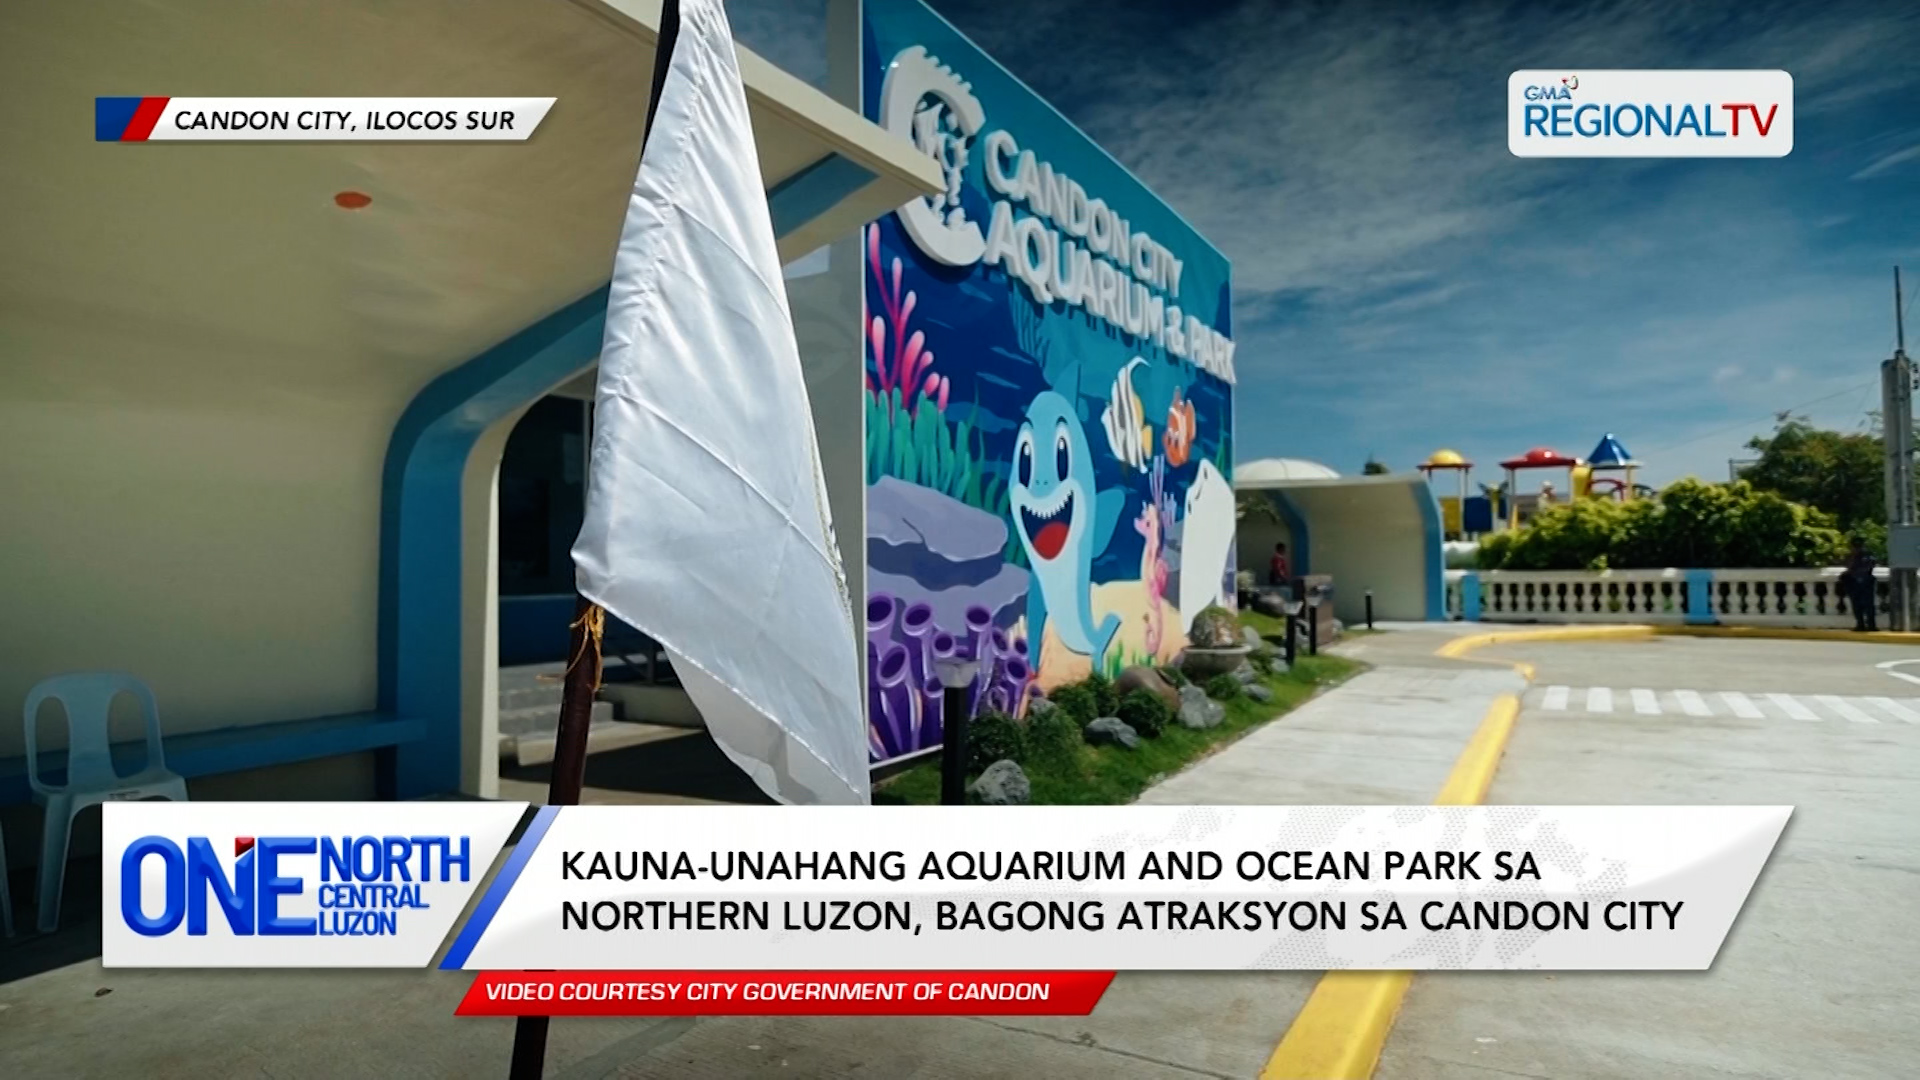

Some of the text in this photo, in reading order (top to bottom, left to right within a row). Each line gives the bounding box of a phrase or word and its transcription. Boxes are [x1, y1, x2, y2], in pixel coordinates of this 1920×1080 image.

[982, 200, 1237, 384] AQUARIUM & PARK
[984, 129, 1184, 298] CANDON CITY
